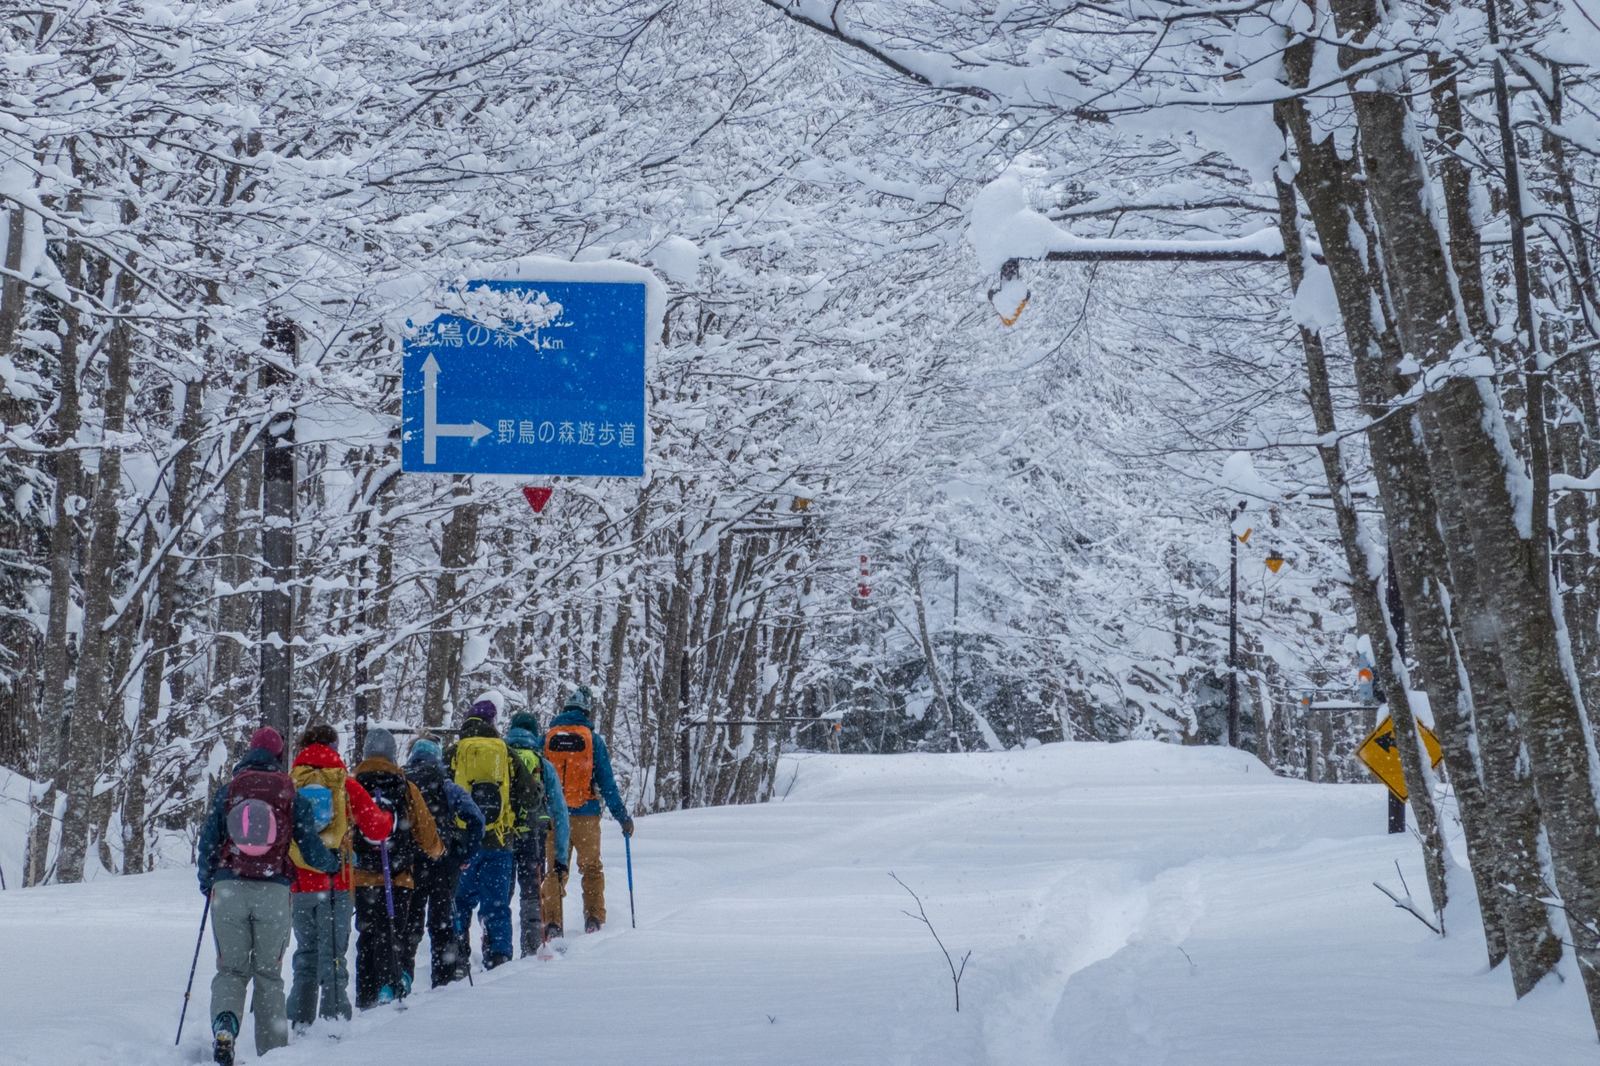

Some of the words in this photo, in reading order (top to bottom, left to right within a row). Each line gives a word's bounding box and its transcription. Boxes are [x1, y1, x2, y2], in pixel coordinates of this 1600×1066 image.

[497, 419, 636, 447] 野鳥の森遊歩道
